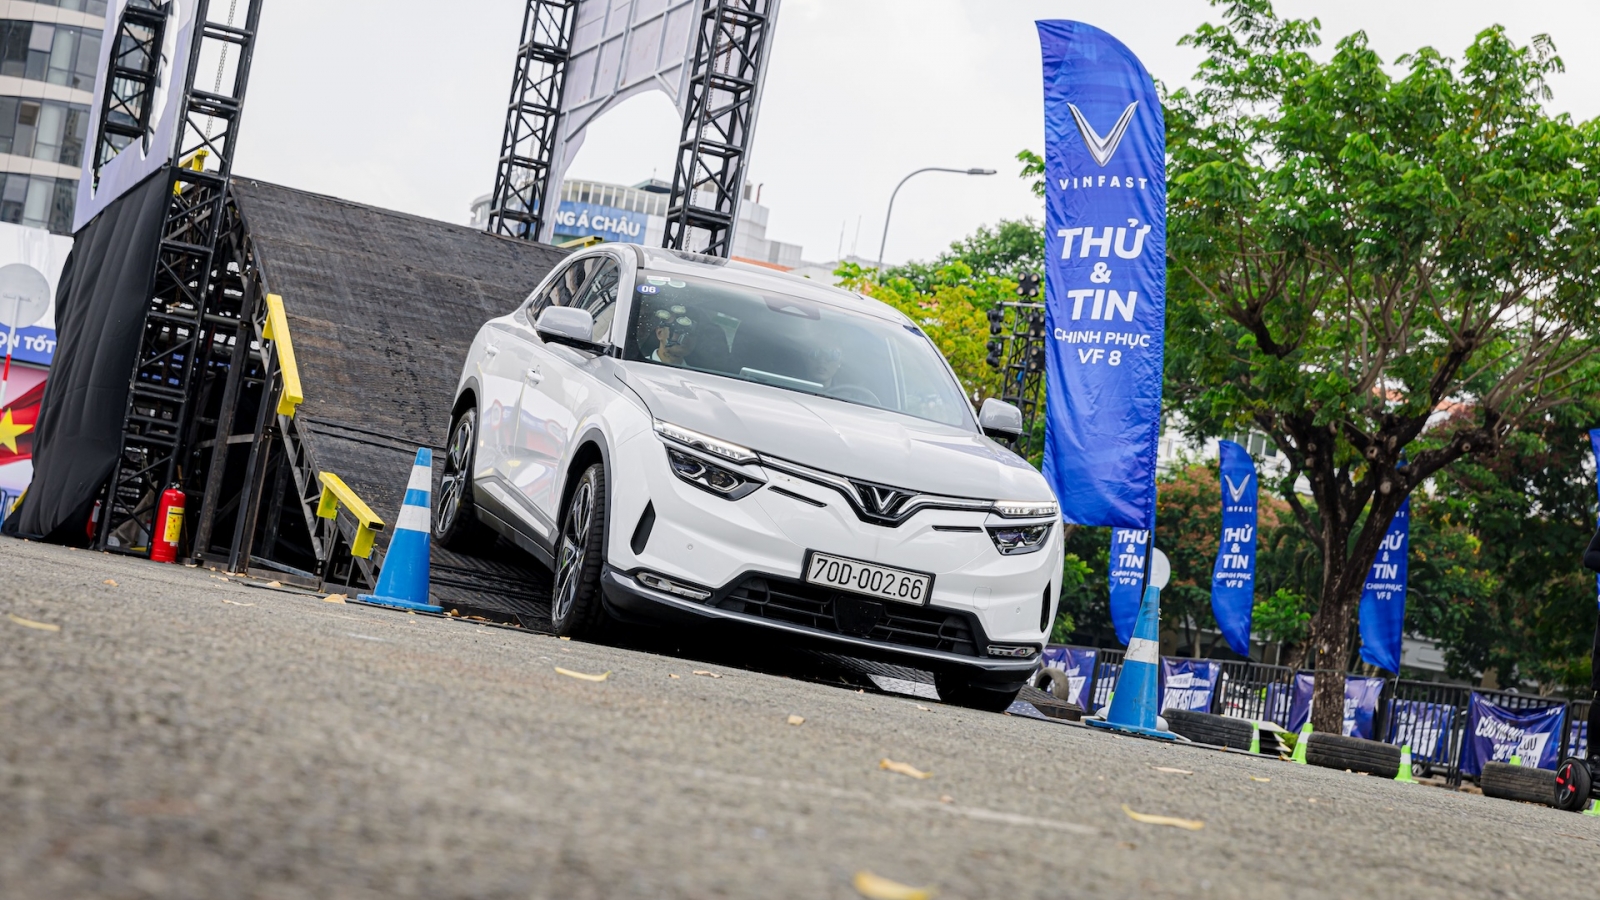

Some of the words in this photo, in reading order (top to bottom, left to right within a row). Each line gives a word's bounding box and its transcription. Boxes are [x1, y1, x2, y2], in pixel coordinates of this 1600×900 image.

[1059, 176, 1148, 190] VINFAST
[591, 215, 641, 237] CHÂU
[1057, 218, 1151, 259] THỬ
[1090, 262, 1112, 284] &
[641, 285, 656, 293] 06
[1067, 289, 1138, 322] TIN
[24, 334, 57, 354] TỐT
[1054, 328, 1101, 344] CHINH
[1104, 332, 1151, 349] PHỤC
[1078, 348, 1105, 364] VF
[1108, 350, 1122, 366] 8
[1126, 544, 1135, 553] &
[1230, 543, 1240, 553] &
[1378, 530, 1405, 551] HỬ
[1119, 554, 1144, 569] TIN
[1223, 554, 1249, 569] TIN
[1382, 551, 1389, 562] &
[813, 558, 923, 600] 70D-002.66
[1373, 563, 1398, 580] TIN
[1130, 578, 1137, 586] 8
[1226, 579, 1237, 588] VF
[1237, 580, 1243, 588] 8
[1376, 591, 1386, 600] VF
[1386, 591, 1392, 600] 8
